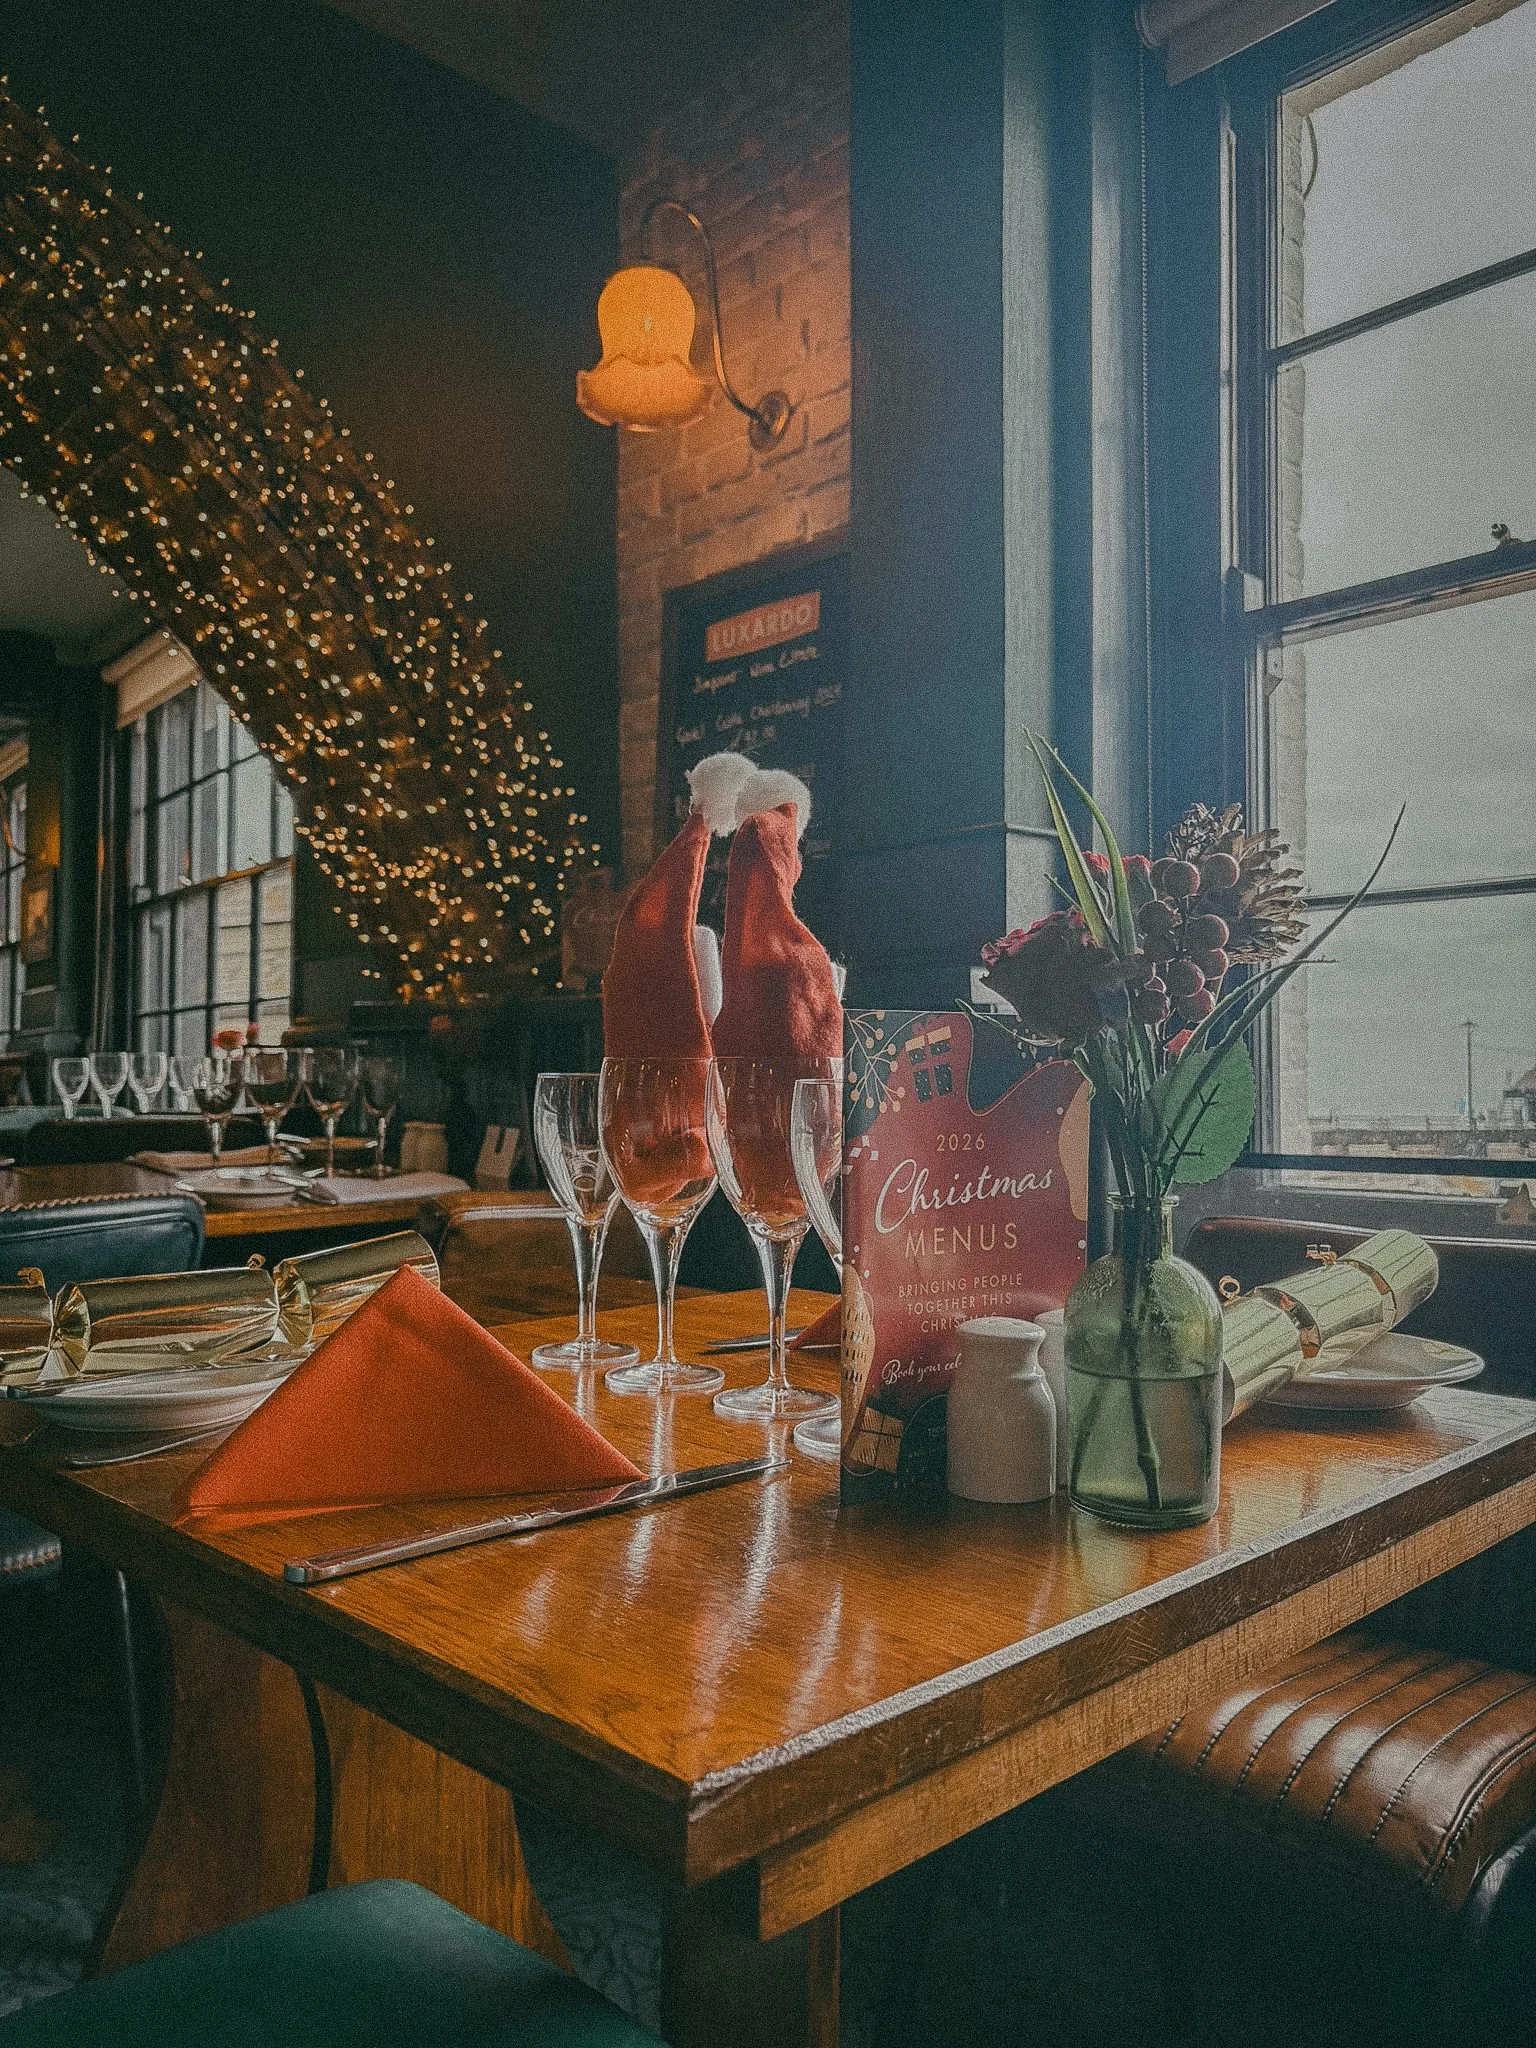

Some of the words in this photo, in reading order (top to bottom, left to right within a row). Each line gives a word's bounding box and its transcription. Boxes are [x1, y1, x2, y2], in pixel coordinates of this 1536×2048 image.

[937, 1133, 985, 1152] 2026
[875, 1158, 1053, 1234] Christmas
[905, 1222, 1018, 1258] MENUS
[898, 1278, 967, 1298] BRINGING
[974, 1273, 1023, 1289] PEOPLE
[907, 1296, 976, 1315] TOGETHER
[982, 1293, 1013, 1306] THIS
[920, 1312, 998, 1333] CHRIS
[881, 1359, 915, 1385] Book
[917, 1363, 941, 1383] your
